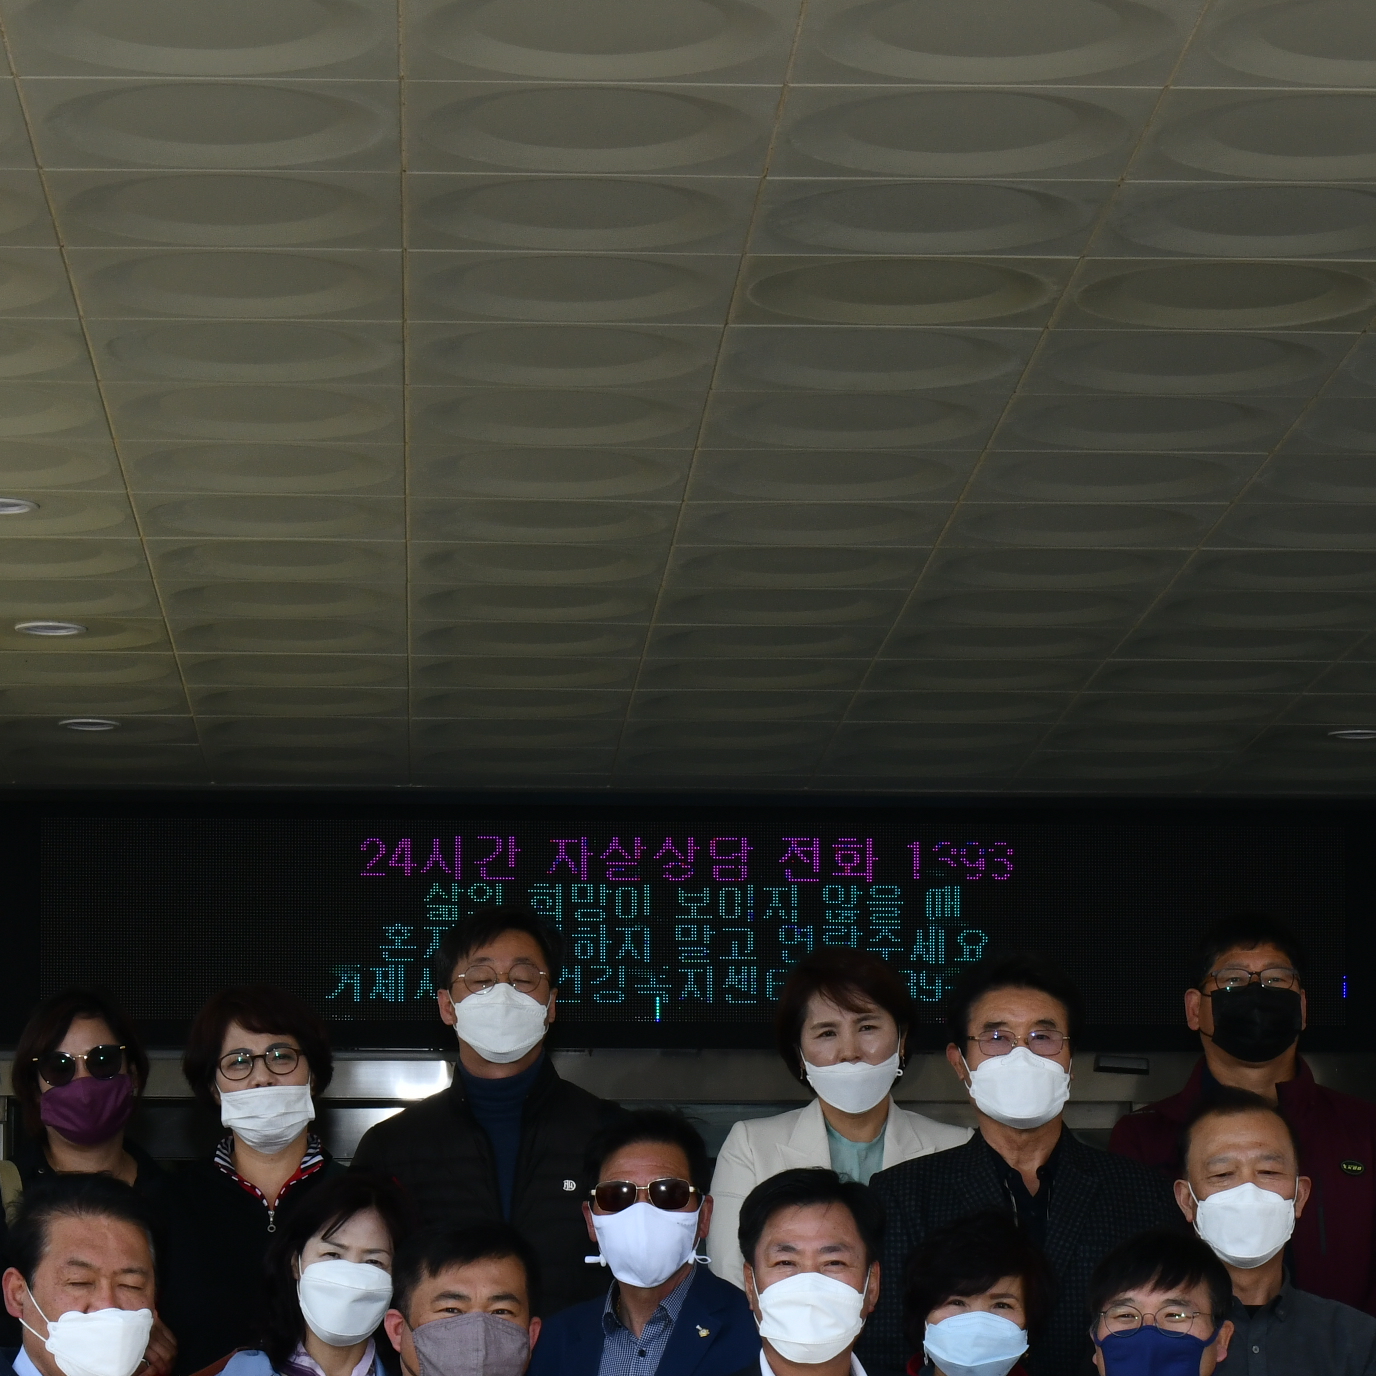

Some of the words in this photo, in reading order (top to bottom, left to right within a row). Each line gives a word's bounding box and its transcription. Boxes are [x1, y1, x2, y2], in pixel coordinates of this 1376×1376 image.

[361, 836, 521, 880] 24시간
[547, 837, 753, 881] 자살상담
[778, 837, 878, 882] 전화
[907, 841, 1014, 880] 1393
[676, 885, 798, 922] 보이지
[822, 885, 904, 922] 않을
[926, 885, 961, 919] 때
[676, 924, 757, 963] 말고
